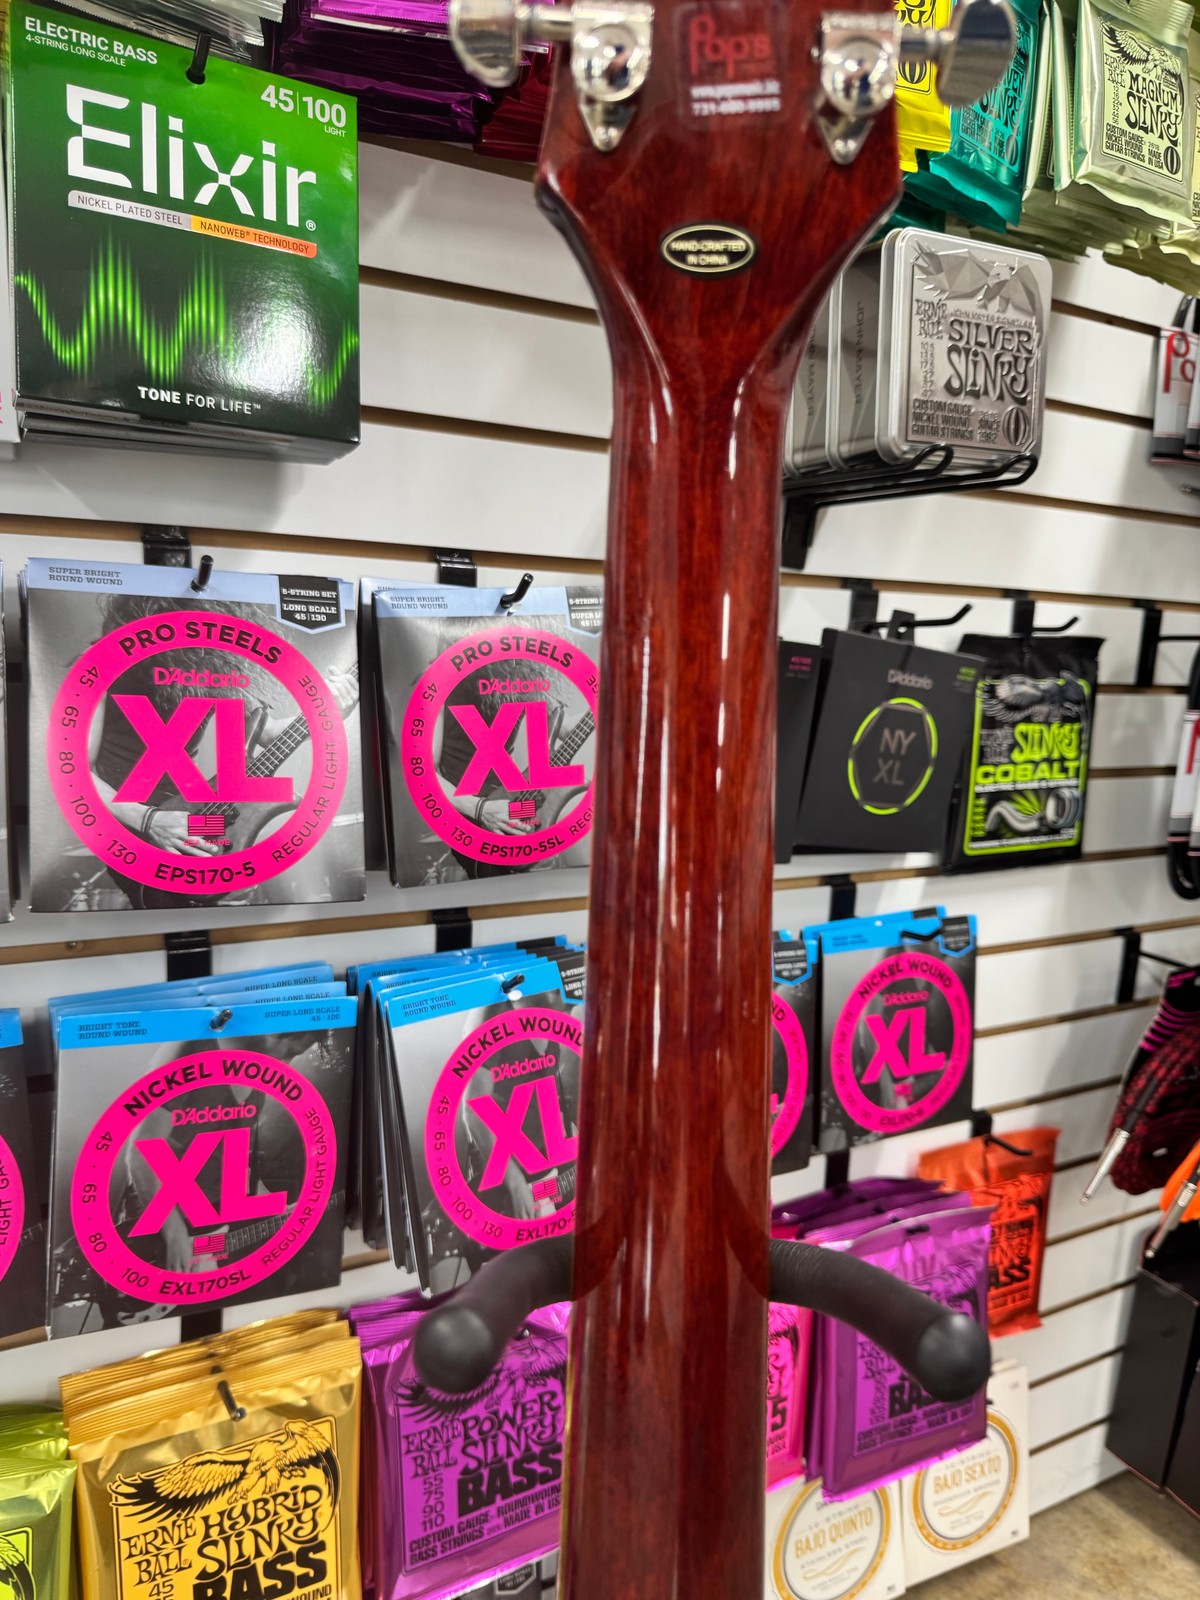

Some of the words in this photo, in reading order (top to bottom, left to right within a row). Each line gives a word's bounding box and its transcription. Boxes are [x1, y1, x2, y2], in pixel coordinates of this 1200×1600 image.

[24, 17, 109, 52] ELECTRIC
[113, 40, 158, 66] BASS
[25, 34, 69, 54] 4-STRING
[70, 44, 95, 60] LONG
[97, 51, 126, 68] SCALE
[1128, 69, 1178, 113] MAGNUM
[324, 125, 347, 138] LIGHT
[1148, 148, 1162, 160] MADE
[77, 194, 113, 211] NICKEL
[115, 203, 152, 219] PLATED
[155, 211, 183, 226] STEEL
[252, 231, 310, 255] TECHNOLOGY
[670, 240, 746, 252] HAND-CRAFTED
[686, 254, 698, 265] IN
[700, 254, 729, 266] CHINA
[948, 319, 1033, 355] SILVER
[943, 344, 1033, 406] SLINKY
[137, 385, 181, 404] TONE
[186, 391, 216, 411] FOR
[49, 567, 80, 577] SUPER
[83, 568, 122, 579] BRIGHT
[49, 574, 83, 585] ROUND
[85, 577, 123, 587] WOUND
[282, 588, 319, 599] 5-STRING
[320, 589, 337, 599] SET
[391, 602, 418, 610] ROUND
[419, 602, 449, 610] WOUND
[283, 603, 307, 613] LONG
[308, 604, 337, 615] SCALE
[118, 623, 176, 657] PRO
[186, 621, 283, 664] STEELS
[450, 640, 493, 672] PRO
[500, 636, 573, 668] STEELS
[79, 665, 100, 688] 45
[154, 667, 250, 690] D'Addario
[478, 677, 550, 695] D'Addario
[298, 674, 336, 732] GAUGE
[422, 681, 439, 703] 45
[61, 706, 80, 729] 65
[411, 718, 425, 738] 65
[112, 694, 294, 803] XL
[448, 701, 585, 797] XL
[880, 728, 917, 755] NY
[1010, 721, 1081, 763] SLINKY
[59, 750, 76, 775] 80
[323, 741, 339, 790] LIGHT
[411, 756, 425, 777] 80
[873, 758, 904, 786] XL
[976, 761, 1080, 785] COBALT
[70, 795, 97, 827] 100
[421, 792, 443, 819] 100
[271, 795, 331, 863] REGULAR
[450, 827, 473, 848] 130
[106, 839, 138, 866] 130
[480, 836, 565, 858] EPS170-5SL
[155, 860, 257, 886] EPS170-5
[292, 975, 318, 986] SCALE
[859, 959, 904, 1000] NICKEL
[908, 958, 952, 989] WOUND
[265, 1009, 292, 1019] SUPER
[293, 1008, 314, 1017] LONG
[315, 1006, 341, 1016] SCALE
[403, 998, 429, 1010] BRIGHT
[430, 994, 449, 1005] TONE
[404, 1007, 429, 1018] ROUND
[430, 1001, 456, 1013] WOUND
[78, 1022, 114, 1033] BRIGHT
[115, 1020, 141, 1030] TONE
[78, 1030, 111, 1040] ROUND
[112, 1028, 148, 1039] WOUND
[452, 1023, 515, 1079] NICKEL
[860, 1006, 946, 1085] XL
[491, 1053, 556, 1083] D'Addario
[123, 1061, 213, 1118] NICKEL
[222, 1058, 303, 1102] WOUND
[171, 1102, 257, 1127] D'Addario
[437, 1095, 449, 1115] 45
[96, 1131, 113, 1153] 45
[305, 1107, 328, 1156] GAUGE
[435, 1131, 446, 1150] 65
[466, 1075, 580, 1192] XL
[127, 1127, 288, 1238] XL
[309, 1159, 328, 1203] LIGHT
[437, 1166, 452, 1186] 80
[82, 1182, 97, 1204] 65
[452, 1196, 474, 1221] 100
[88, 1231, 107, 1253] 80
[261, 1206, 313, 1267] REGULAR
[482, 1220, 504, 1239] 130
[121, 1266, 149, 1289] 100
[159, 1269, 252, 1296] EXL170SL
[461, 1390, 560, 1440] POWER
[402, 1418, 462, 1455] ERNIE
[460, 1413, 558, 1477] SLINKY
[411, 1444, 458, 1480] BALL
[423, 1474, 444, 1491] 55
[458, 1442, 562, 1519] BASS
[423, 1486, 444, 1505] 75
[200, 1484, 322, 1540] HYBRID
[422, 1500, 445, 1519] 90
[121, 1511, 197, 1560] ERNIE
[409, 1526, 454, 1554] CUSTOM
[457, 1511, 490, 1535] GAUGE
[410, 1544, 438, 1567] BASS
[440, 1528, 485, 1554] STRINGS
[504, 1509, 530, 1529] MADE
[535, 1502, 545, 1517] IN
[421, 1513, 445, 1533] 110
[828, 1506, 873, 1544] QUINTO
[193, 1540, 328, 1600] BASS
[150, 1578, 174, 1598] 45
